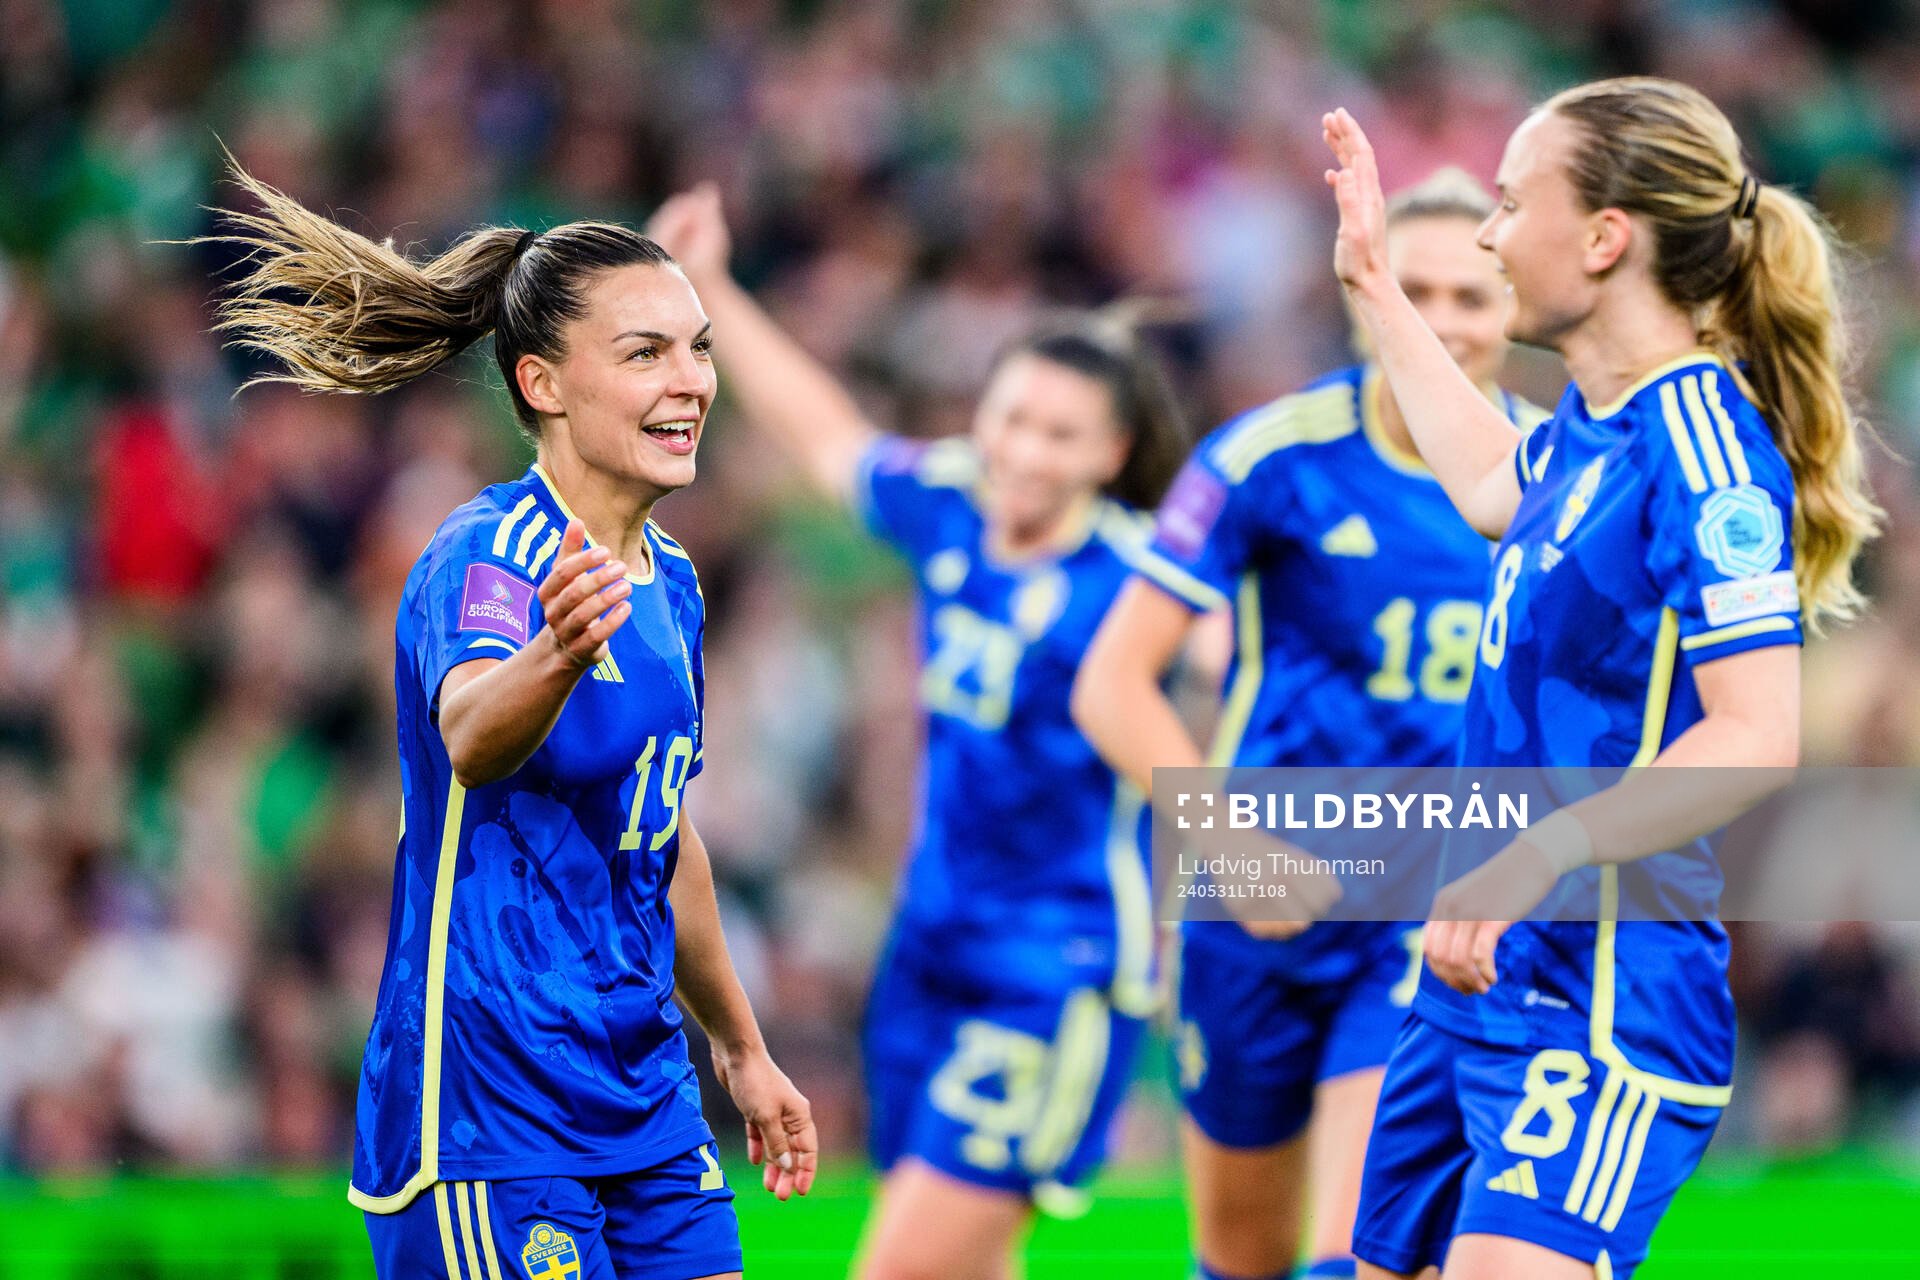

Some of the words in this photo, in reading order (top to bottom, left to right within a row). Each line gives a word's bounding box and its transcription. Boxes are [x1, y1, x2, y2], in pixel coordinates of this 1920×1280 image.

[1367, 597, 1482, 704] 18
[1482, 543, 1523, 671] 8
[618, 735, 693, 851] 19
[1501, 1049, 1591, 1159] 8
[531, 1243, 568, 1261] SVERIGE
